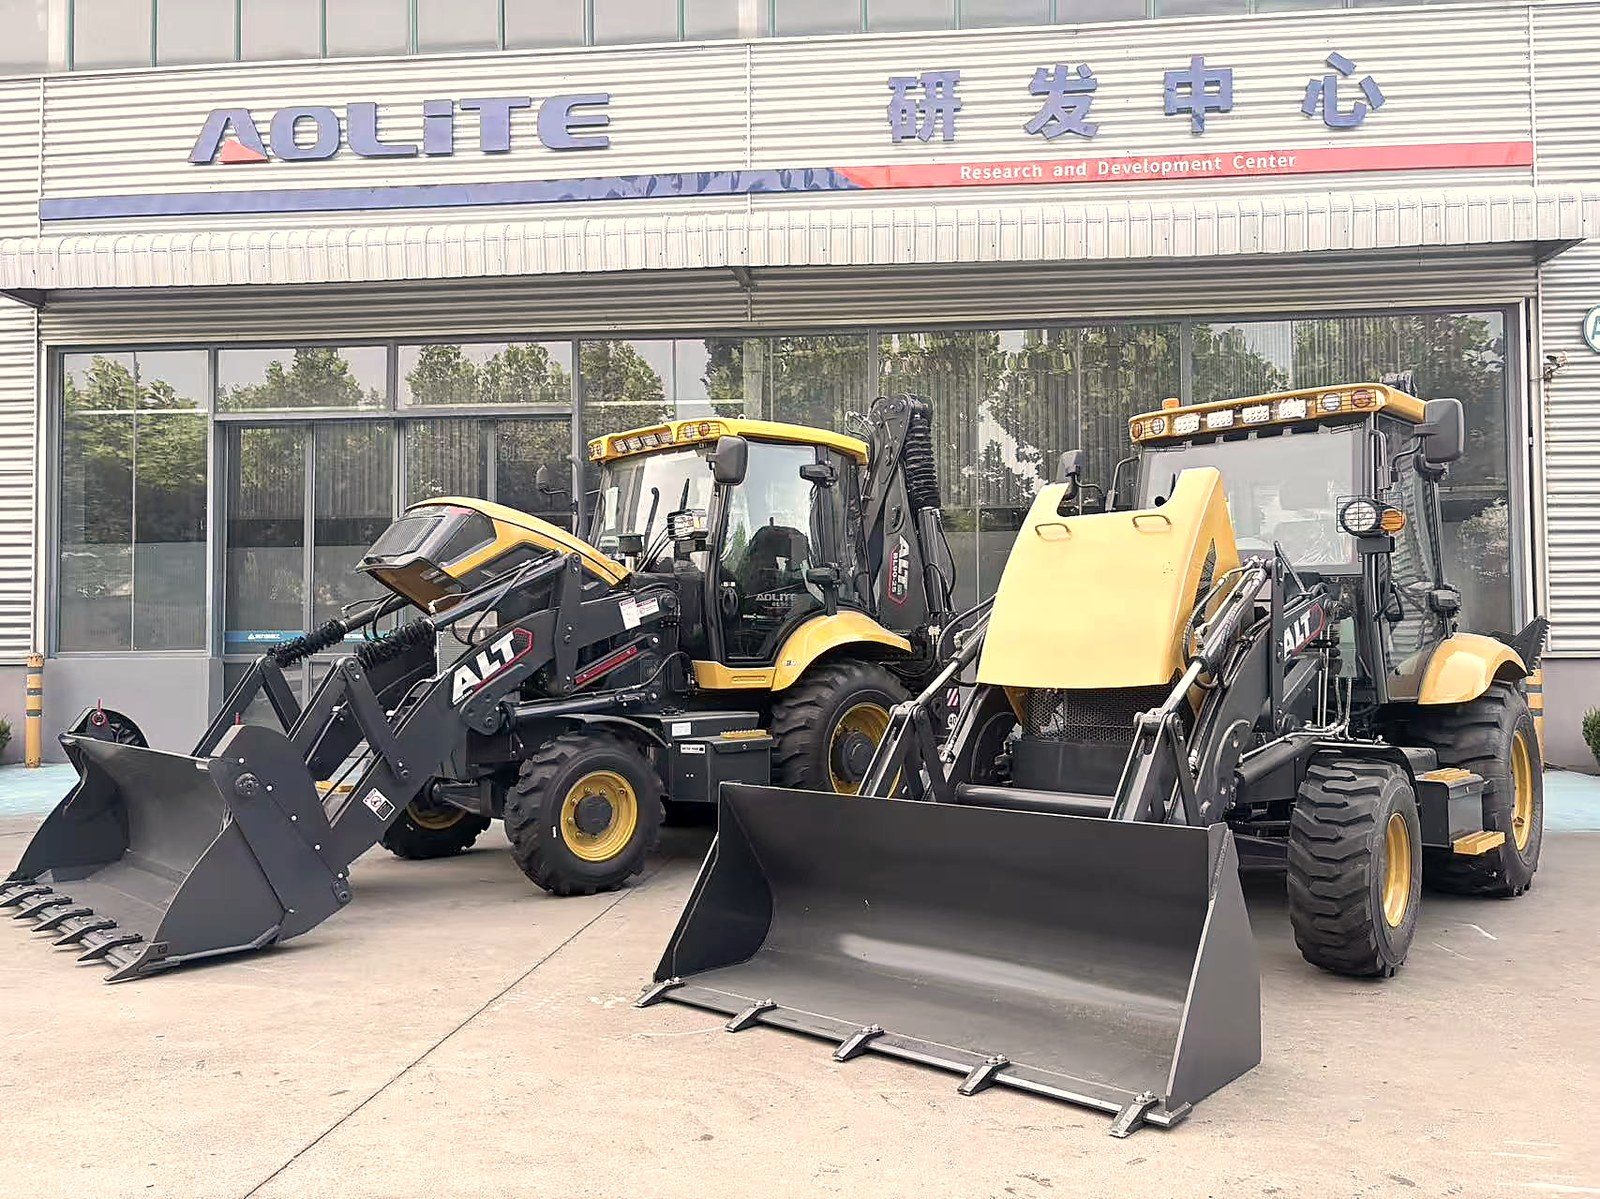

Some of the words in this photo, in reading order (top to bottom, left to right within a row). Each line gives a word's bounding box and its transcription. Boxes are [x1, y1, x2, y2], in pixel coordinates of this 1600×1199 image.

[887, 52, 1385, 143] 研发中心
[959, 164, 1043, 180] Research
[1053, 161, 1088, 177] and
[1099, 156, 1222, 177] Development
[1232, 153, 1297, 170] Center
[1283, 609, 1311, 659] ALT
[452, 631, 515, 704] ALT
